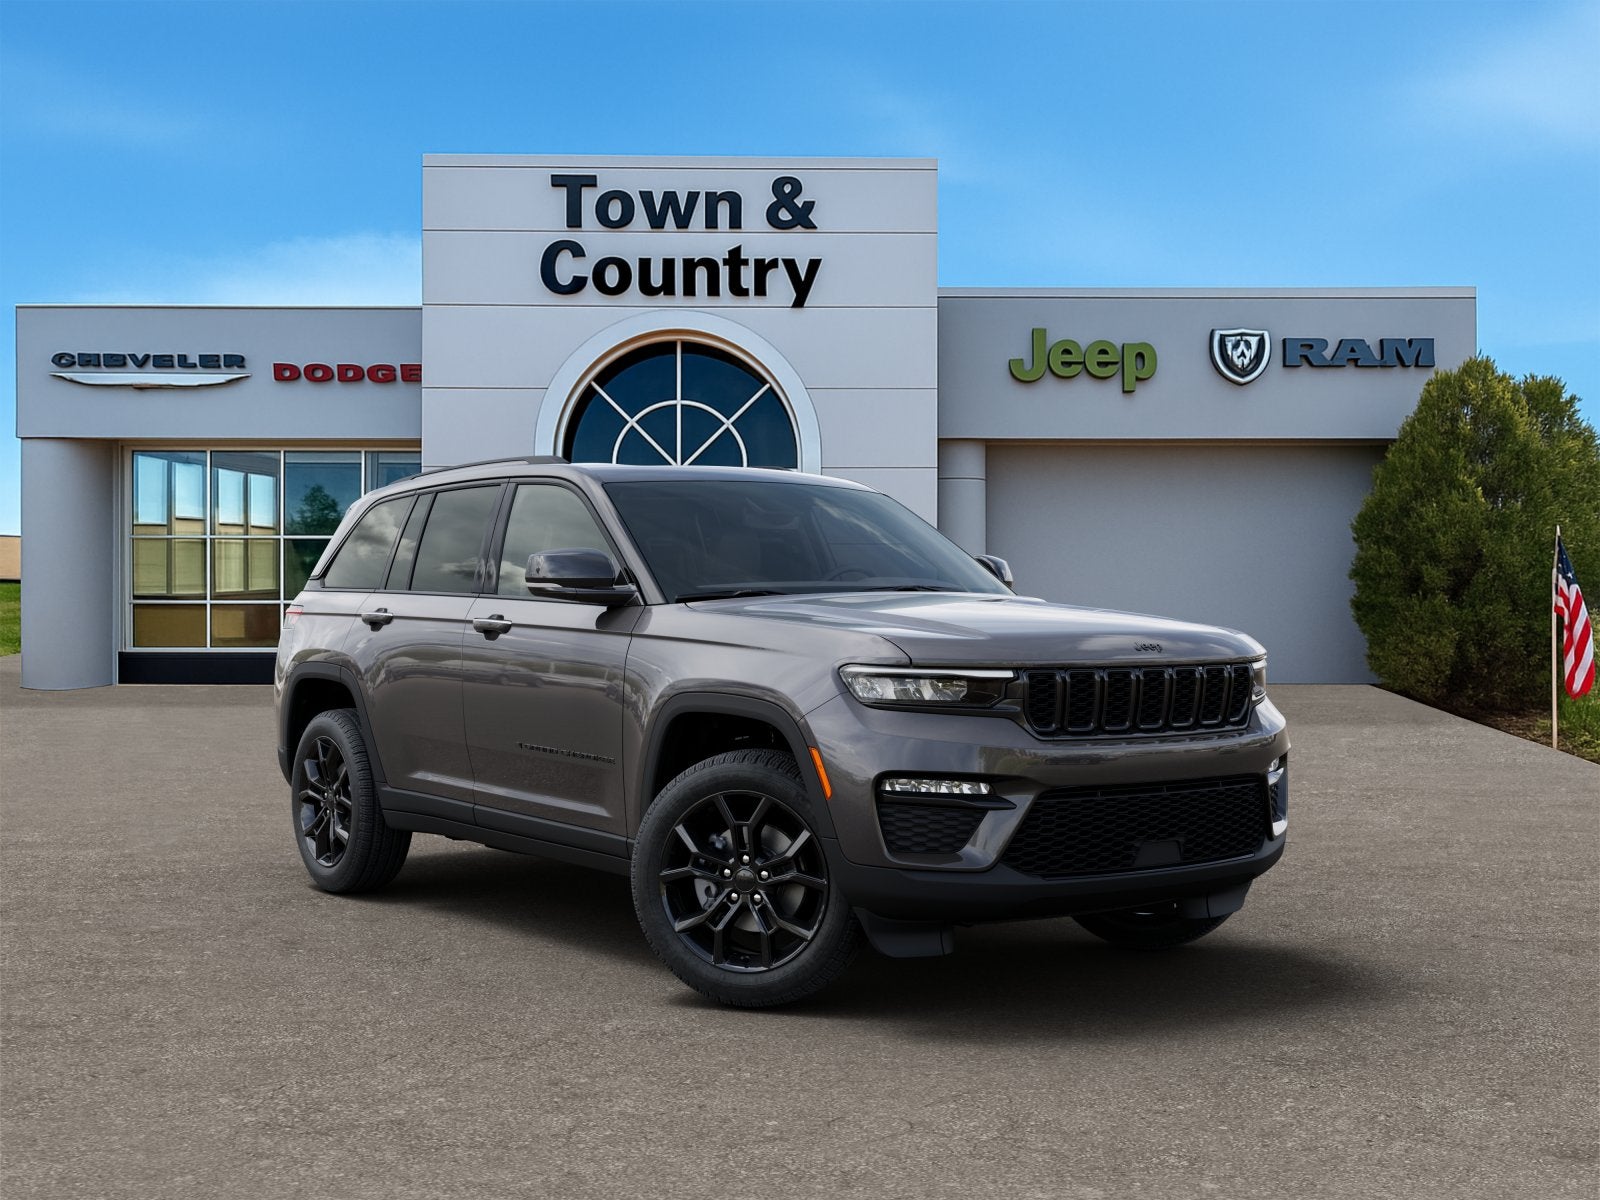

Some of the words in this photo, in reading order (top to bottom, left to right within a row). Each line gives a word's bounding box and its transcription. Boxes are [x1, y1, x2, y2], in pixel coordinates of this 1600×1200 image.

[550, 174, 742, 230] Town
[765, 176, 818, 230] &
[540, 239, 823, 308] Country
[272, 362, 422, 384] DODGE
[1008, 328, 1158, 394] Jeep
[1282, 337, 1436, 368] RAM
